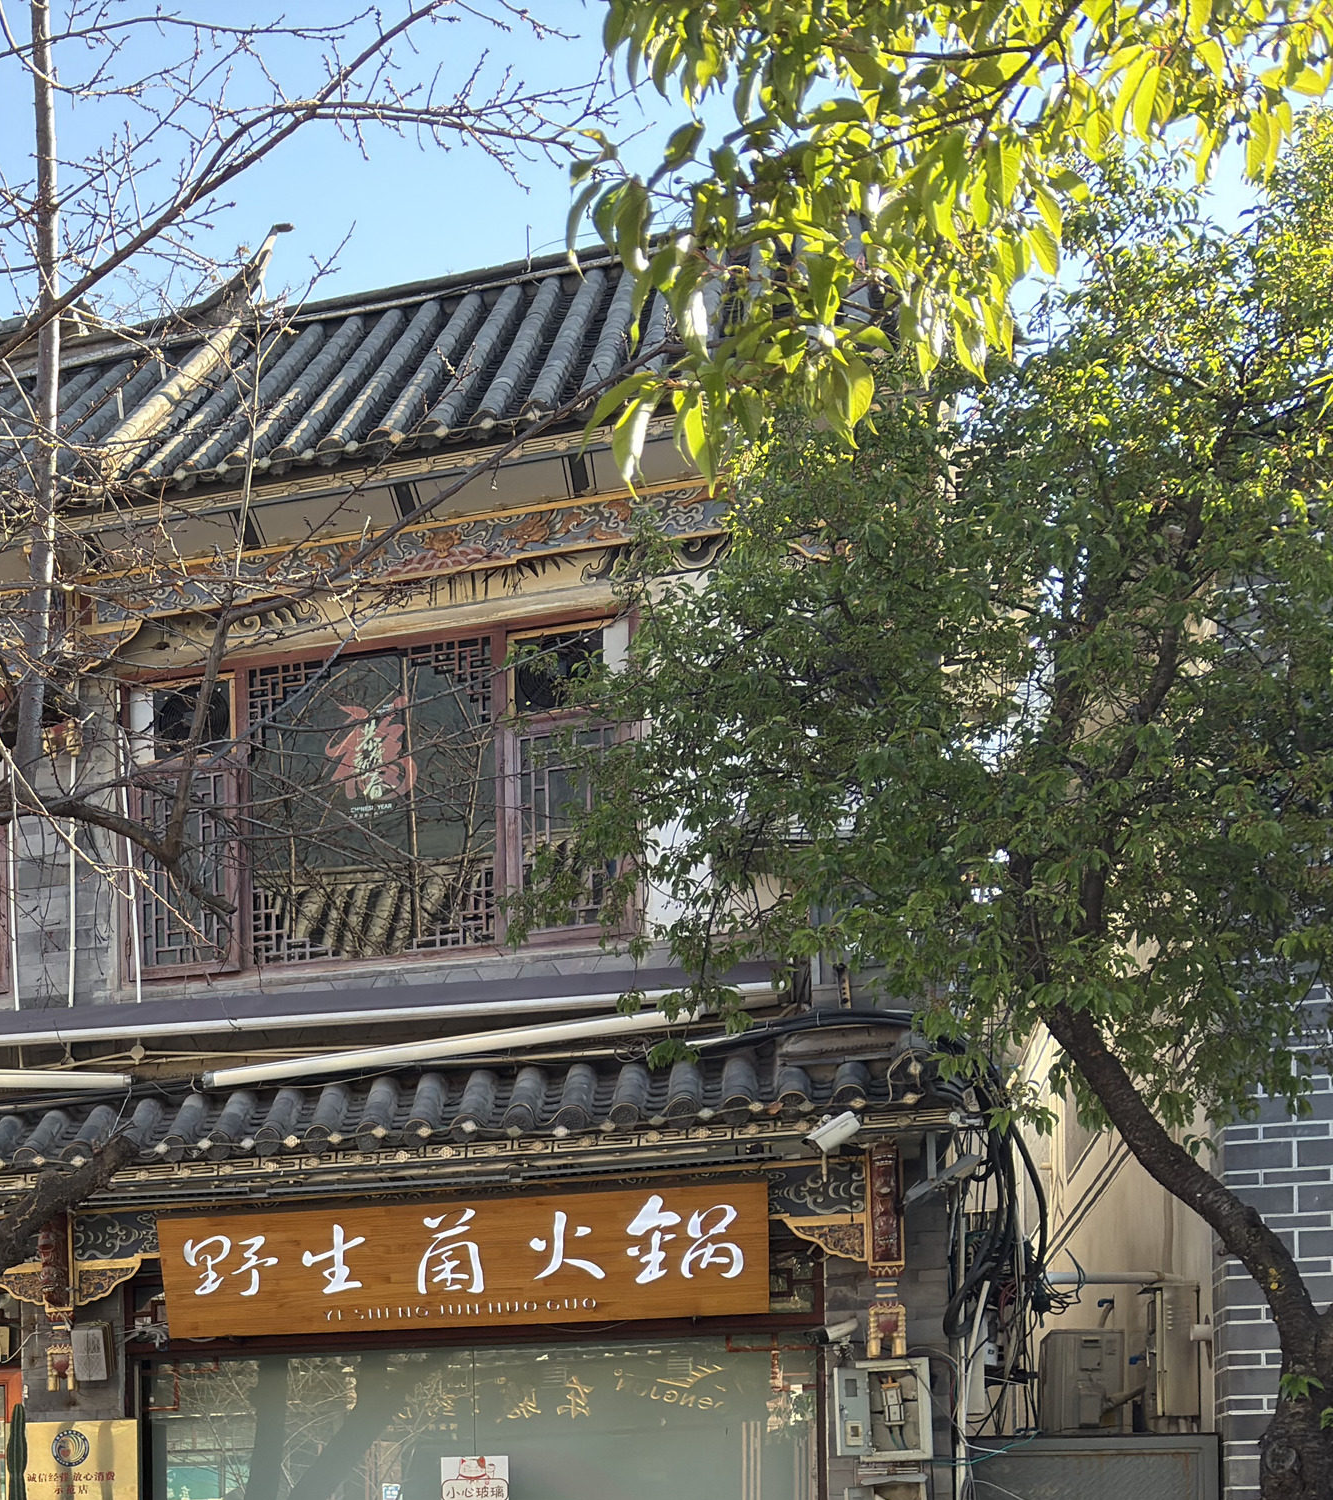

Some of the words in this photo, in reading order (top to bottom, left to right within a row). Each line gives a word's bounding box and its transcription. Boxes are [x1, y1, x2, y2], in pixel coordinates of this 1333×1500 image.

[183, 1194, 745, 1297] 野生菌火锅
[353, 1305, 430, 1321] SHENG
[438, 1302, 482, 1317] JUN
[490, 1299, 539, 1315] HUO
[546, 1296, 598, 1312] GUO
[27, 1472, 70, 1483] 诚信经营
[72, 1471, 116, 1483] 放心消费
[54, 1484, 89, 1495] 示范店
[446, 1484, 505, 1500] 小心玻璃
